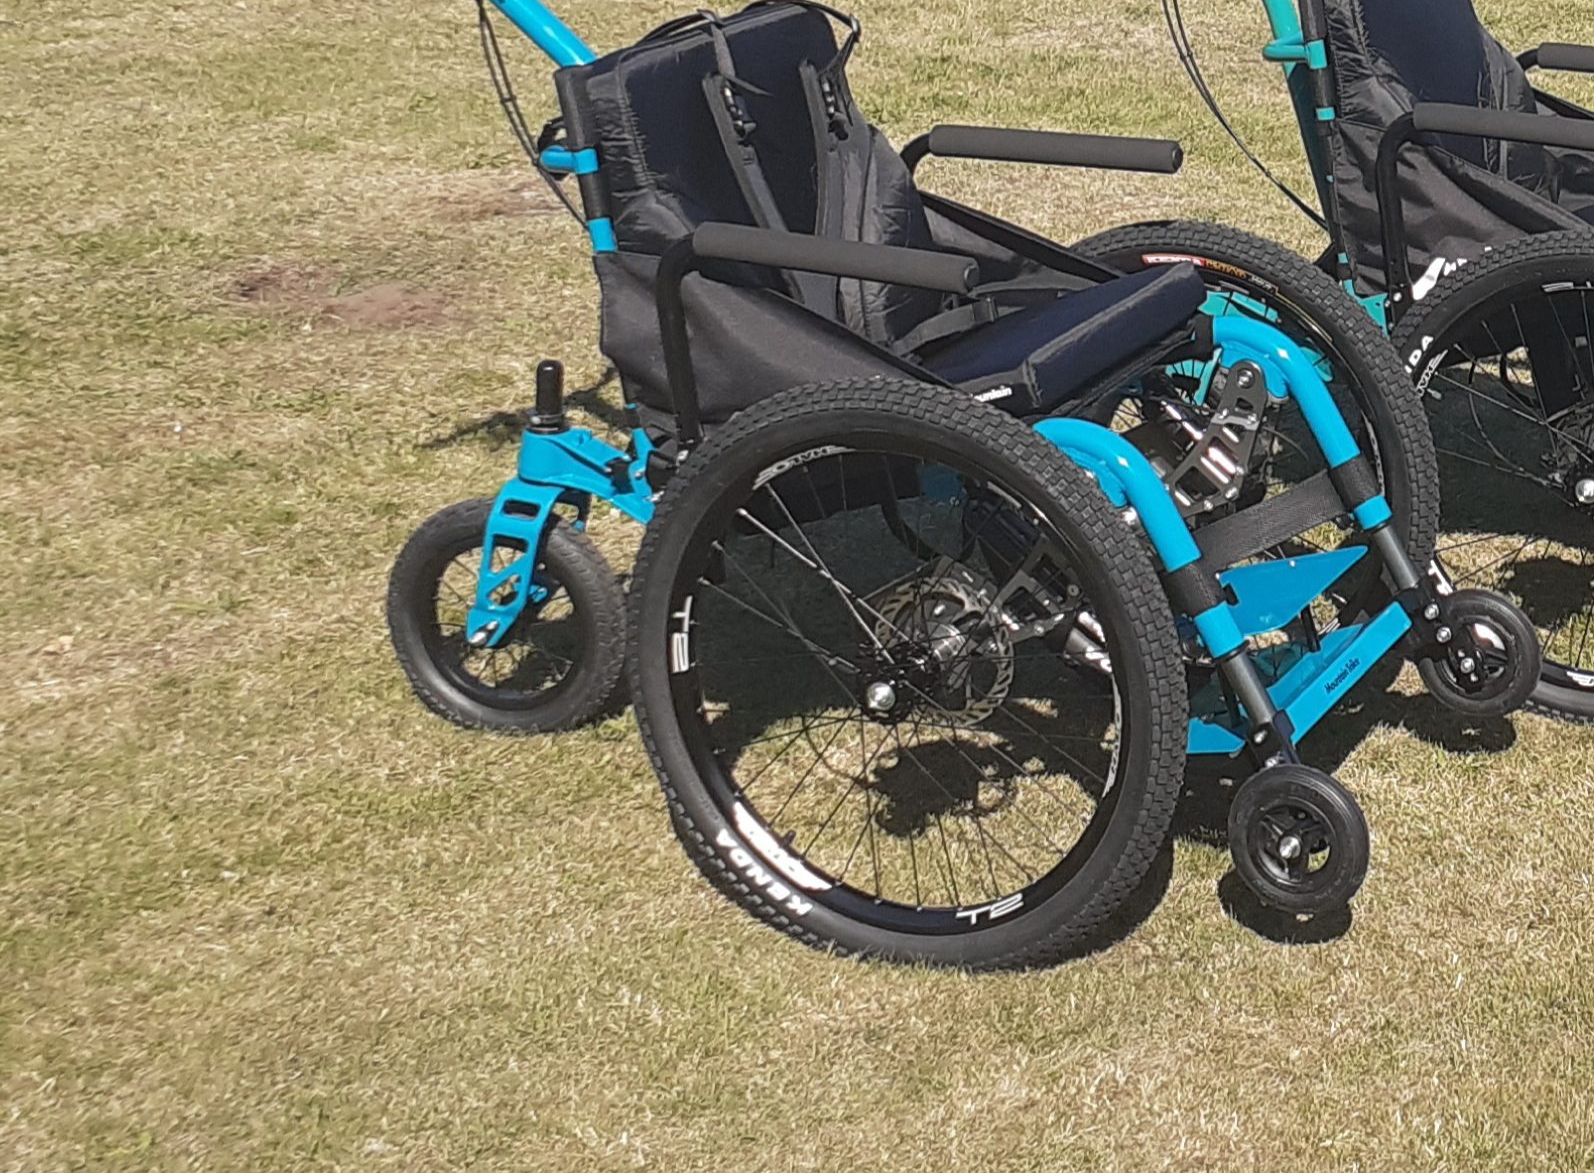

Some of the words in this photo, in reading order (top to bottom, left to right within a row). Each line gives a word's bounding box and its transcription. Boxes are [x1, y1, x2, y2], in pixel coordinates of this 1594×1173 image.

[672, 595, 693, 673] T2
[1324, 669, 1349, 695] Mountain
[716, 828, 813, 916] KENDA
[956, 892, 1024, 925] T2
